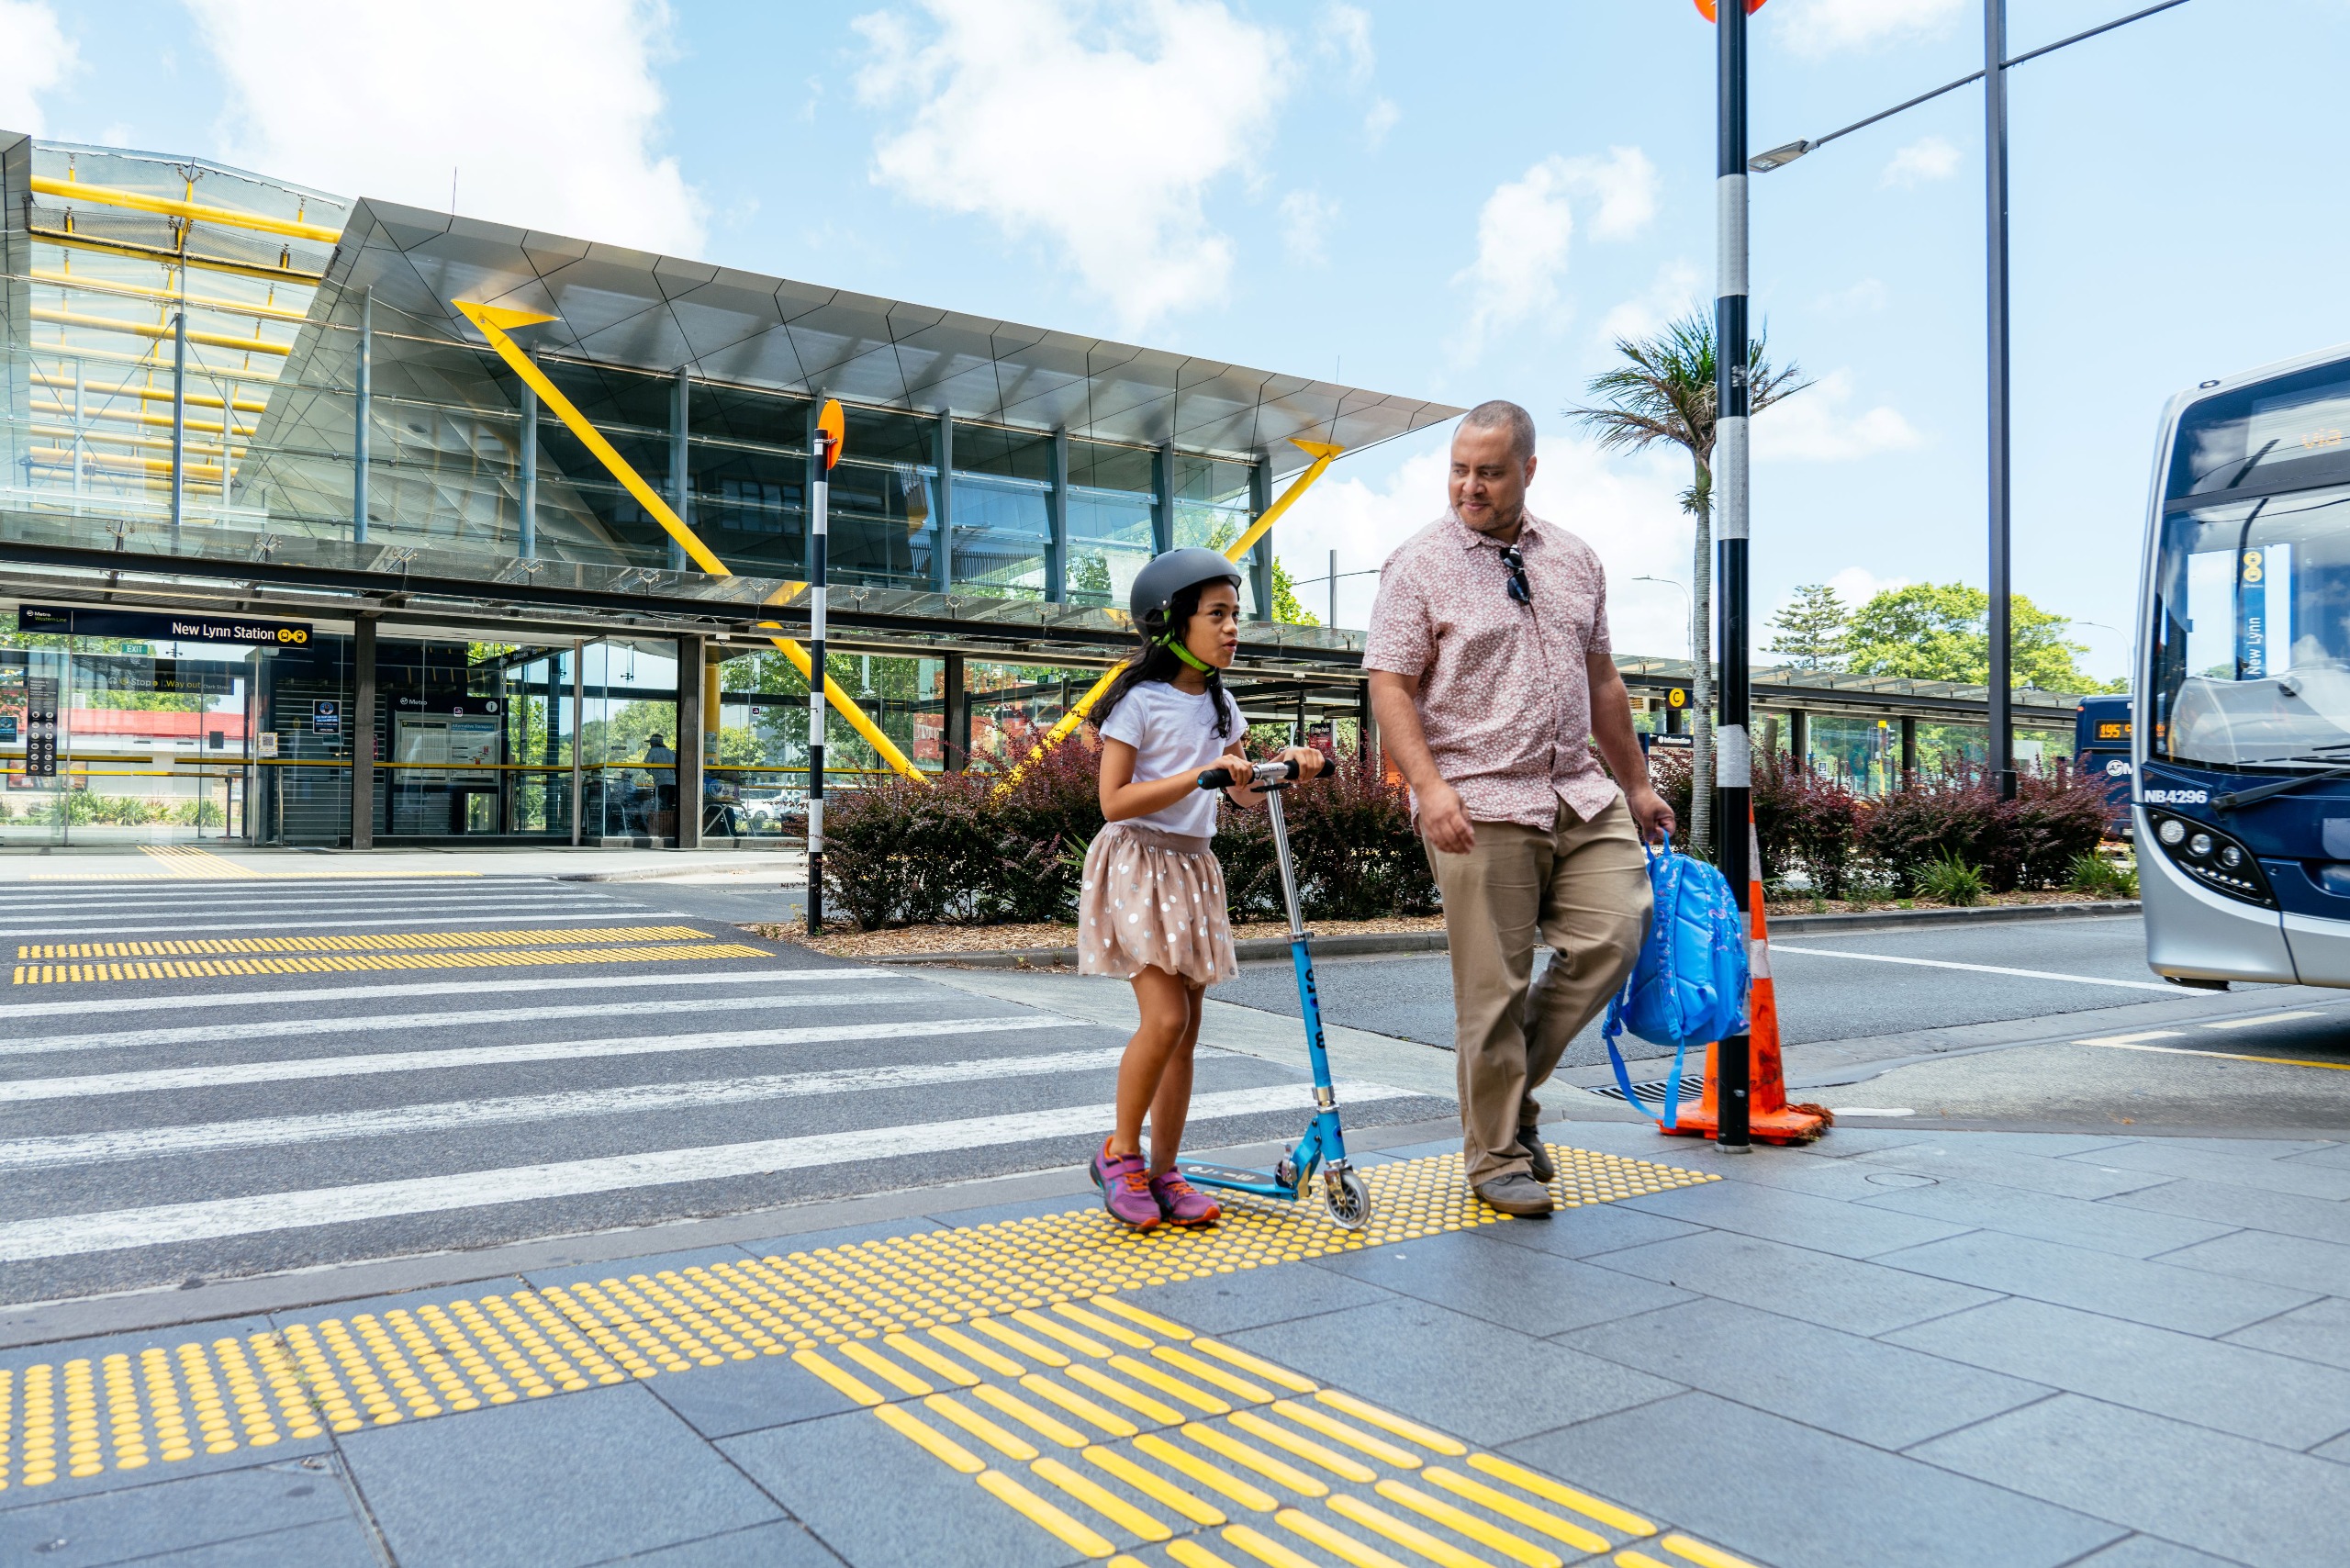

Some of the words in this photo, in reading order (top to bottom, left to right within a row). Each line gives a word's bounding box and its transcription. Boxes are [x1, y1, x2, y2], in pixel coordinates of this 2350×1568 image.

[2300, 428, 2342, 449] via
[172, 622, 199, 635] New
[203, 623, 231, 639] Lynn
[233, 626, 275, 641] Station
[2246, 617, 2264, 644] Lynn
[2246, 648, 2262, 675] New
[131, 678, 151, 687] Stop
[165, 680, 185, 689] Way
[1673, 691, 1680, 703] C
[2098, 724, 2121, 738] 195
[2143, 790, 2208, 803] NB4296
